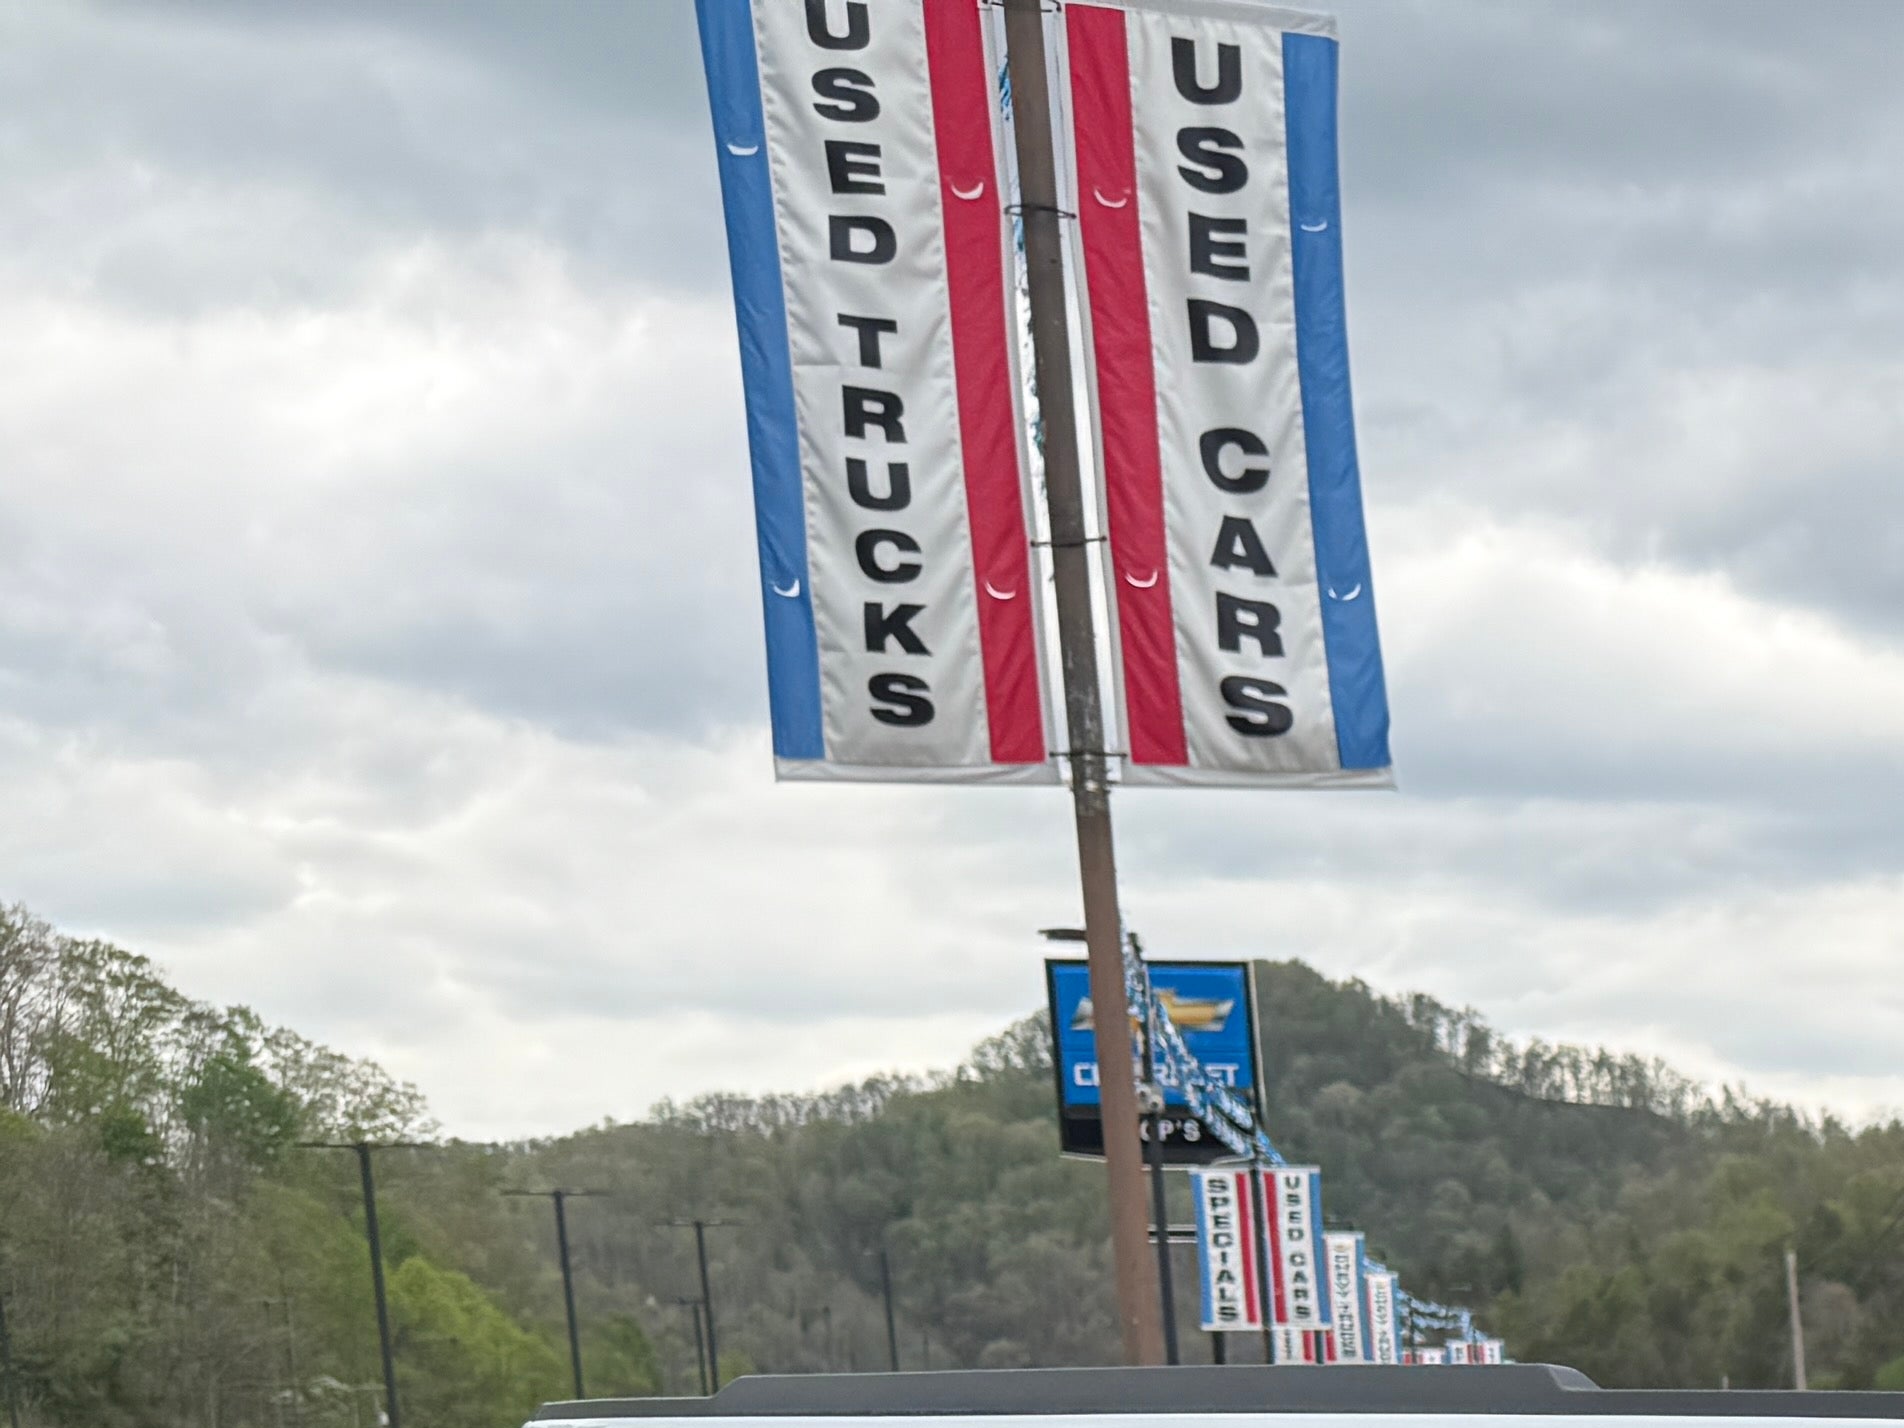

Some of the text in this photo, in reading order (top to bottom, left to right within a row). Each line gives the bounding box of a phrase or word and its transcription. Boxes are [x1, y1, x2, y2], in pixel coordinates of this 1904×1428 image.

[806, 0, 936, 728] USED TRUCKS
[1171, 36, 1294, 738] USED CARS
[1207, 1177, 1240, 1323] SPECIALS
[1284, 1175, 1305, 1242] USED
[1289, 1252, 1311, 1319] CARS
